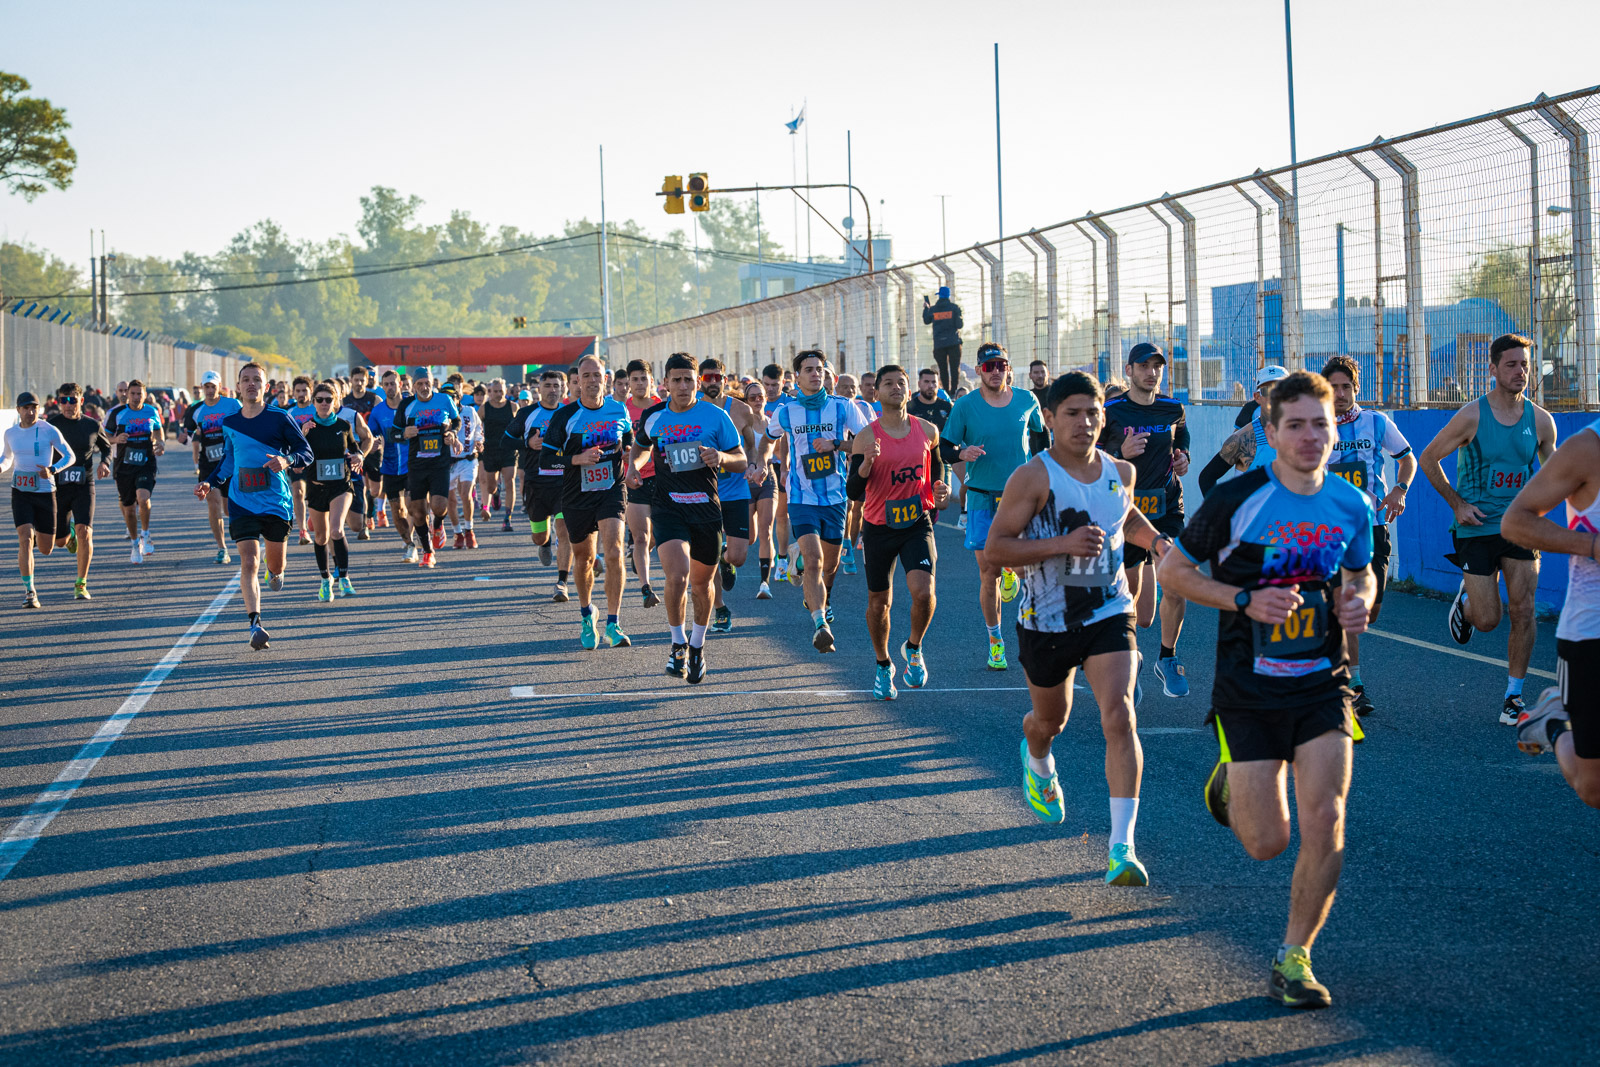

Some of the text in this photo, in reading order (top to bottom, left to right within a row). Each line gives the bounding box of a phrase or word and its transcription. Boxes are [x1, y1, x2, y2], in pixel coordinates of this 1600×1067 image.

[794, 423, 834, 434] GUEPARD
[423, 439, 438, 450] 797
[1332, 439, 1372, 451] UEPARD
[129, 451, 143, 462] 140
[673, 447, 698, 466] 105
[808, 455, 832, 473] 705
[64, 470, 82, 482] 167
[325, 464, 337, 476] 21
[587, 467, 609, 483] 359
[891, 464, 923, 486] KRC
[16, 475, 36, 487] 374
[244, 473, 266, 488] 312
[1495, 471, 1523, 488] 344
[1134, 496, 1158, 514] 782
[892, 503, 918, 523] 712
[1071, 548, 1110, 575] 174
